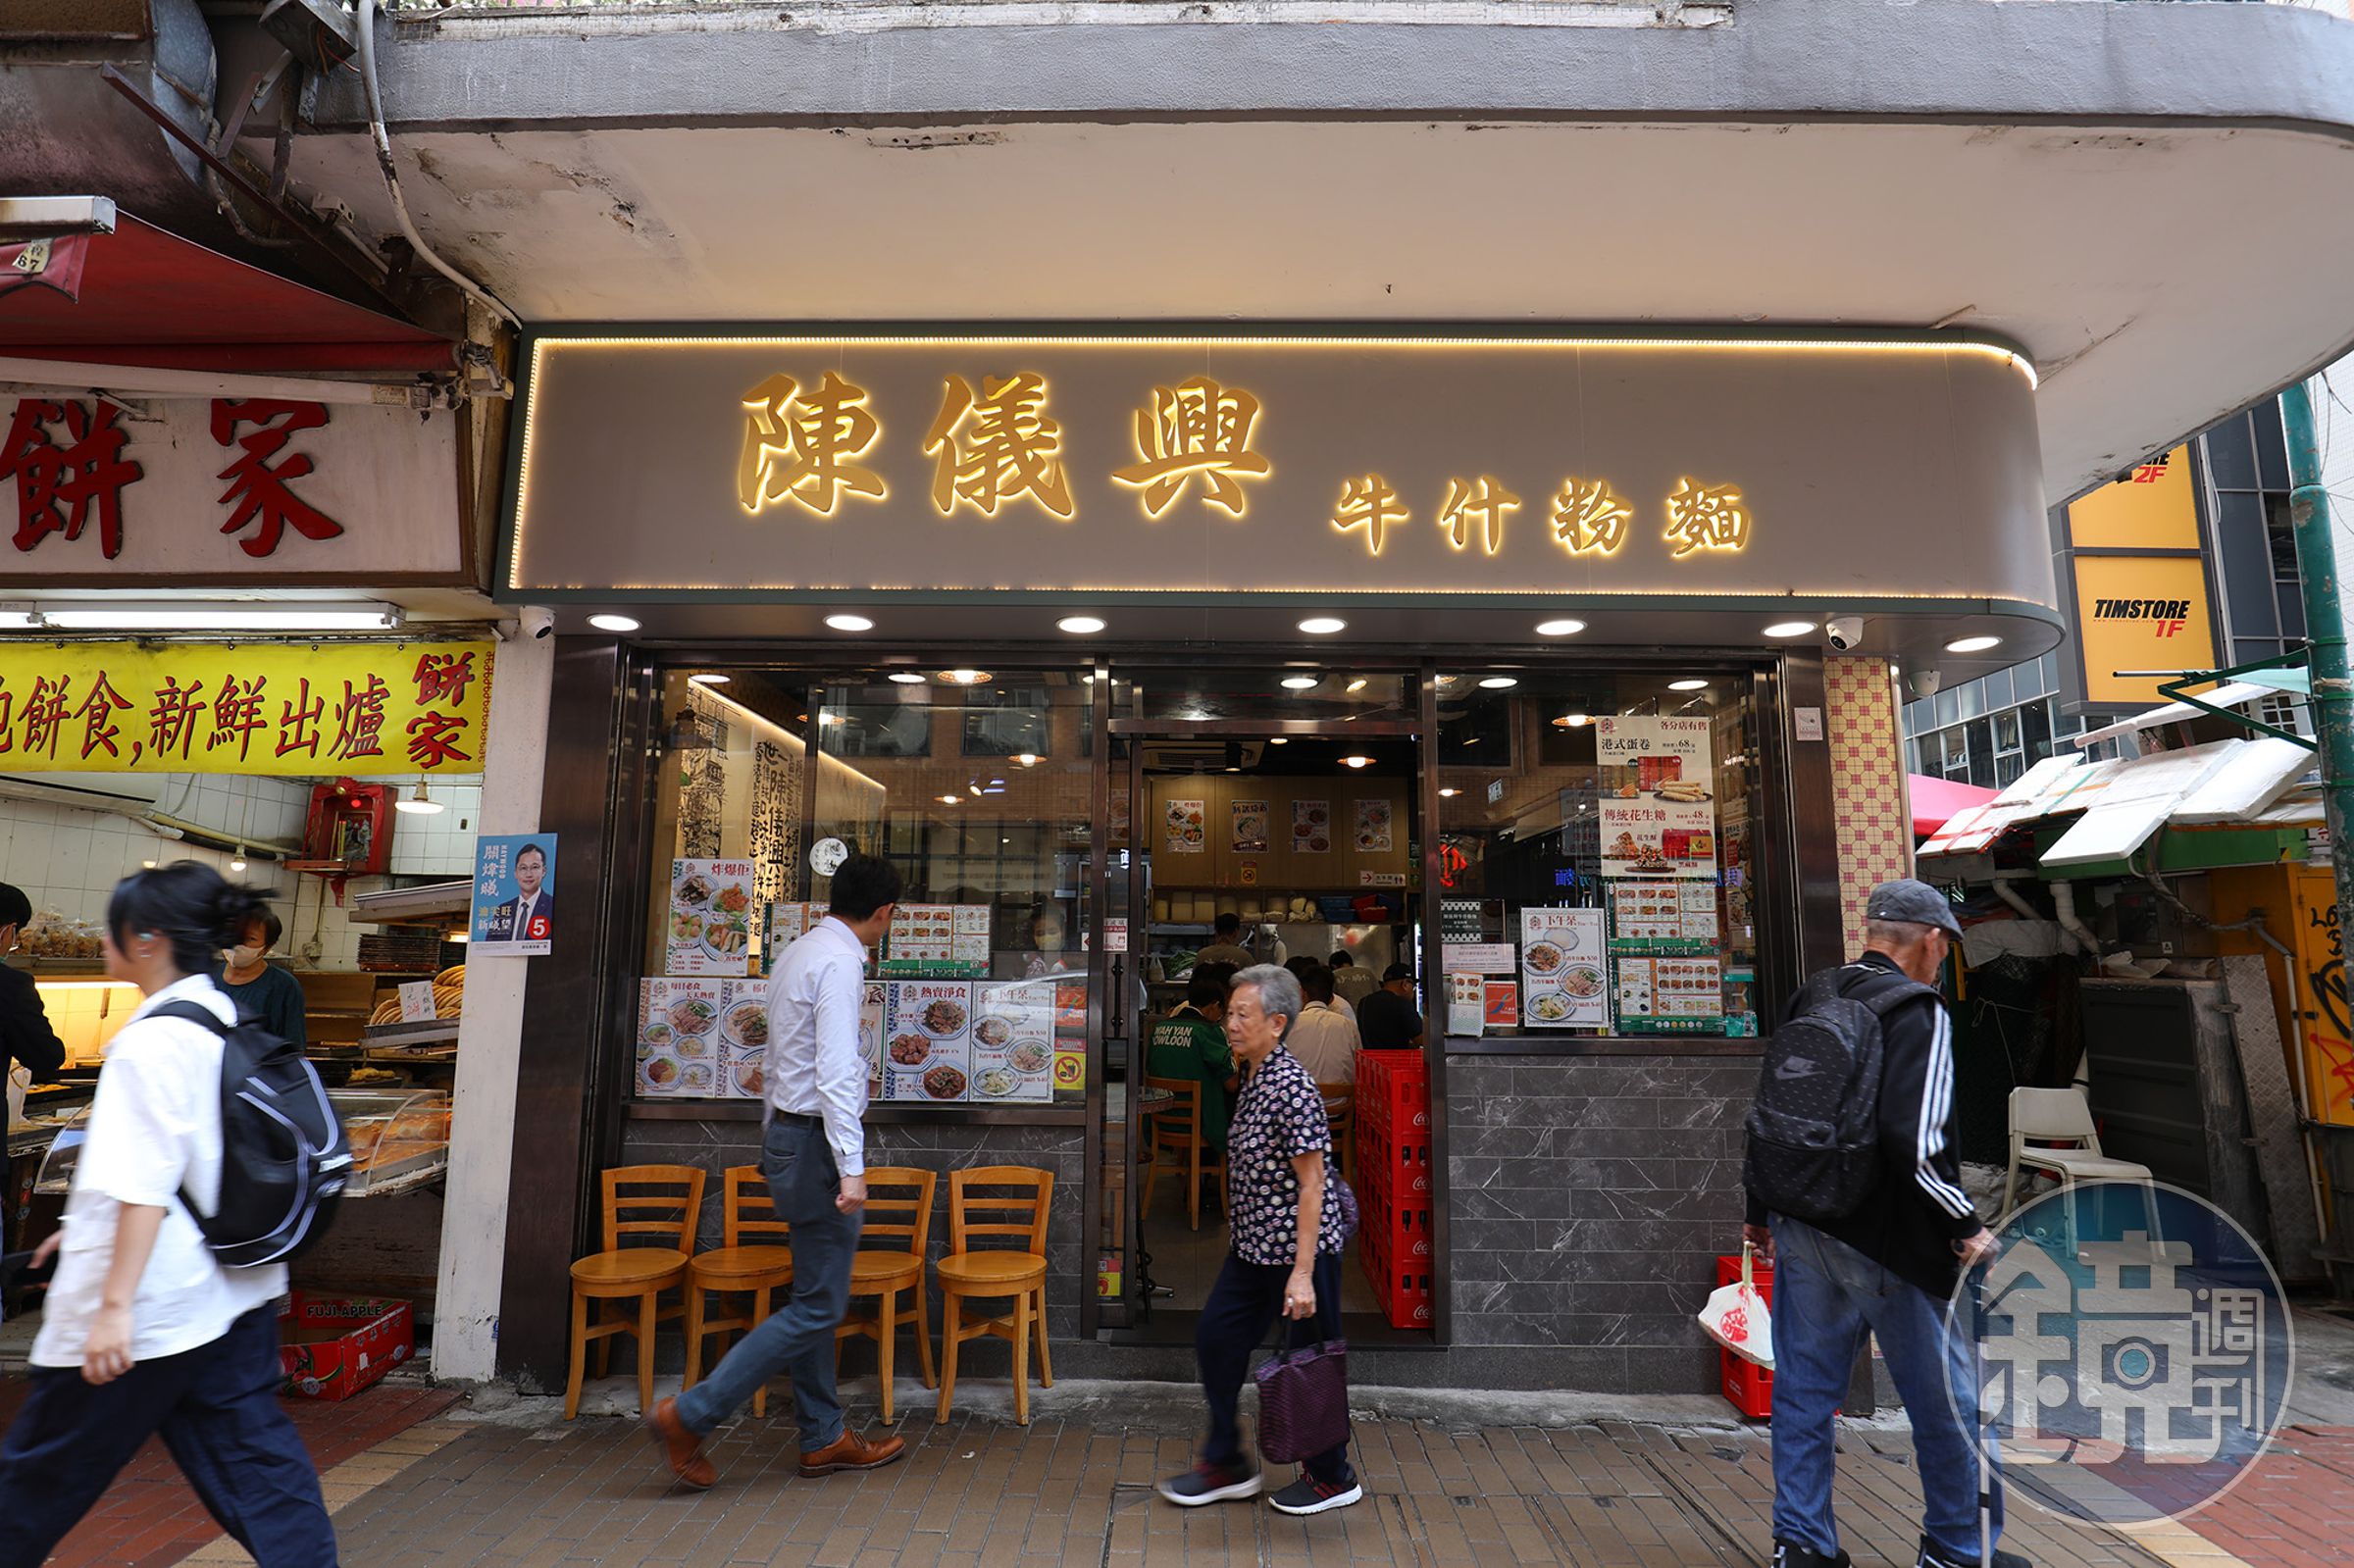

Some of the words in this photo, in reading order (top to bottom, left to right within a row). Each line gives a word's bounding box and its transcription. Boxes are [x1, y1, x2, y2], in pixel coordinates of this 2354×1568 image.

[740, 371, 1269, 517] 陳儀興
[1333, 474, 1750, 555] 牛什粉麵
[0, 399, 344, 560] 餅家
[2133, 466, 2168, 483] 2F
[2093, 599, 2191, 619] TIMSTORE
[2156, 620, 2185, 637] 1F
[405, 650, 476, 770] 餅家
[1660, 721, 1707, 731] 各分店有售
[1601, 737, 1651, 750] 港式蛋卷
[1605, 809, 1666, 821] 傳統花生糖
[533, 919, 546, 936] 5
[1174, 1027, 1193, 1037] YAN
[1152, 1036, 1193, 1047] OWLOON
[306, 1305, 337, 1318] FUJI
[340, 1305, 383, 1319] APPLE
